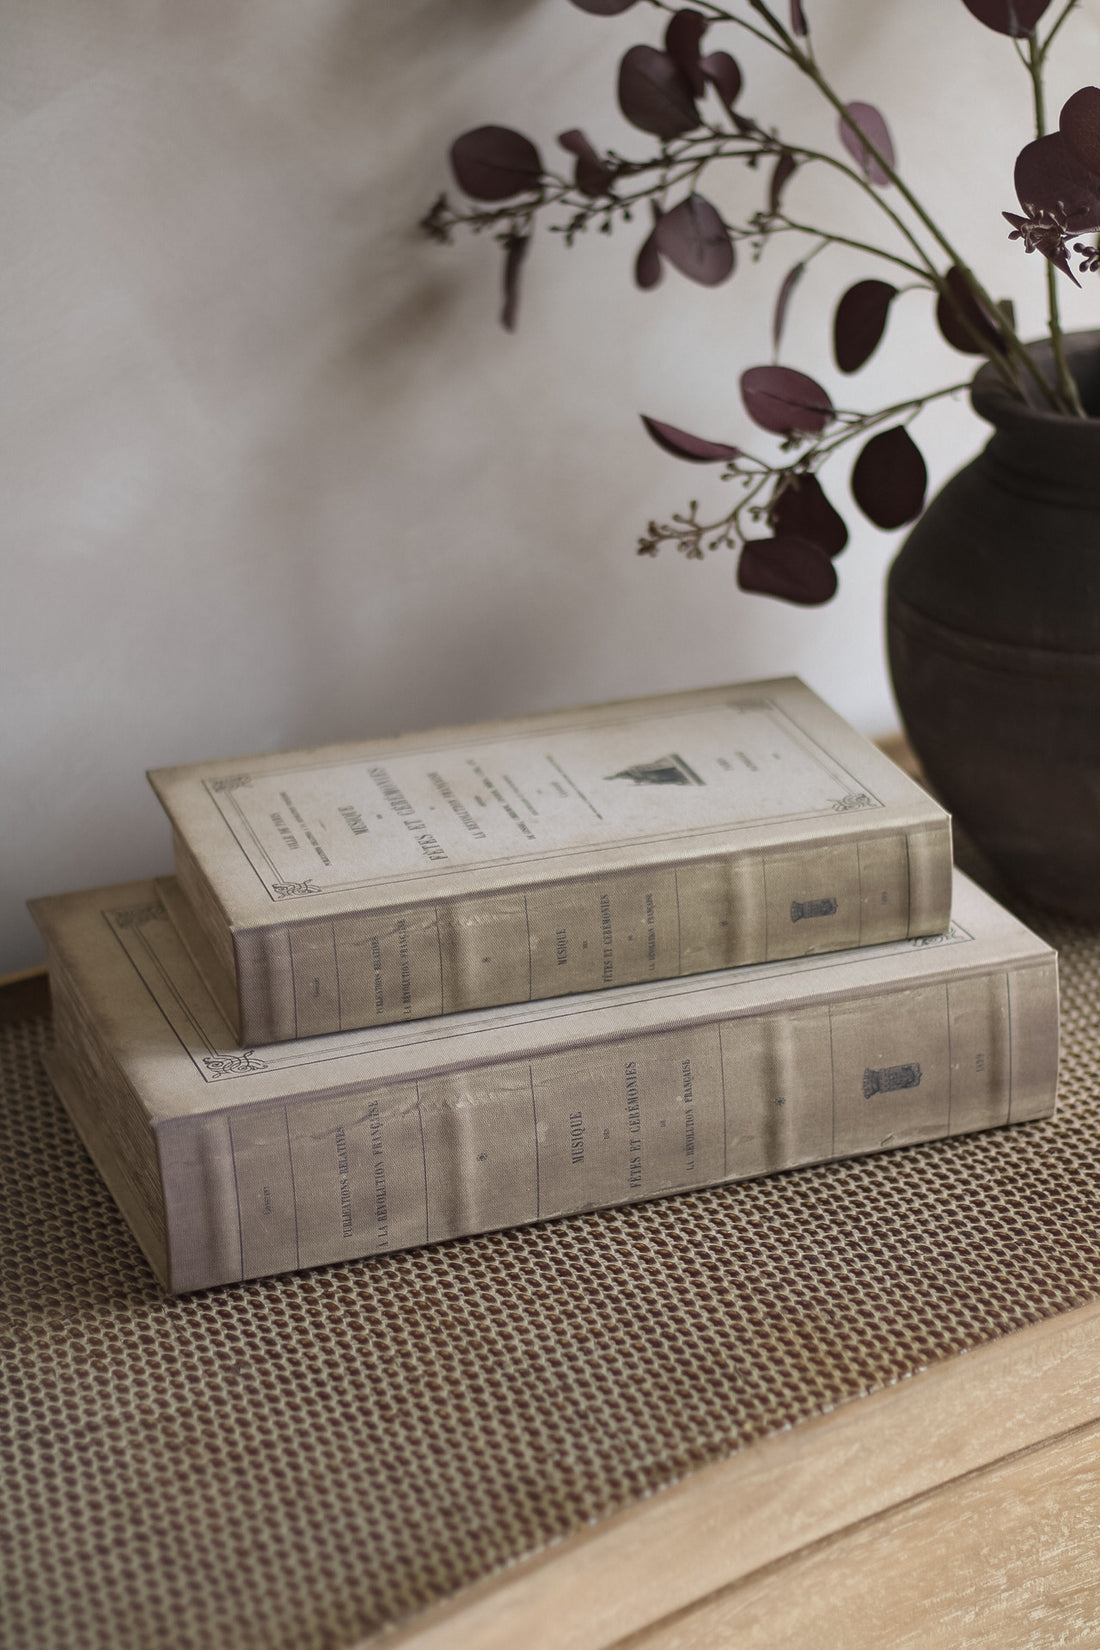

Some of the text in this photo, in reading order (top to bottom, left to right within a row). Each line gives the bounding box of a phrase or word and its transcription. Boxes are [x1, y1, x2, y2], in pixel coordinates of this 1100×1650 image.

[337, 805, 369, 836] MUSIQUE
[403, 819, 426, 831] ET
[556, 928, 569, 966] MUSIQUE
[603, 948, 613, 958] ET
[368, 1100, 384, 1156] FRANÇAISE
[569, 1111, 586, 1165] MUSIQUE
[629, 1139, 642, 1152] ET
[627, 1156, 642, 1189] FÊTES
[686, 1160, 695, 1171] LA
[335, 1126, 353, 1239] PUBLICATIONS RELATIVES
[375, 1161, 388, 1223] RÉVOLUTION
[378, 1225, 389, 1239] LA
